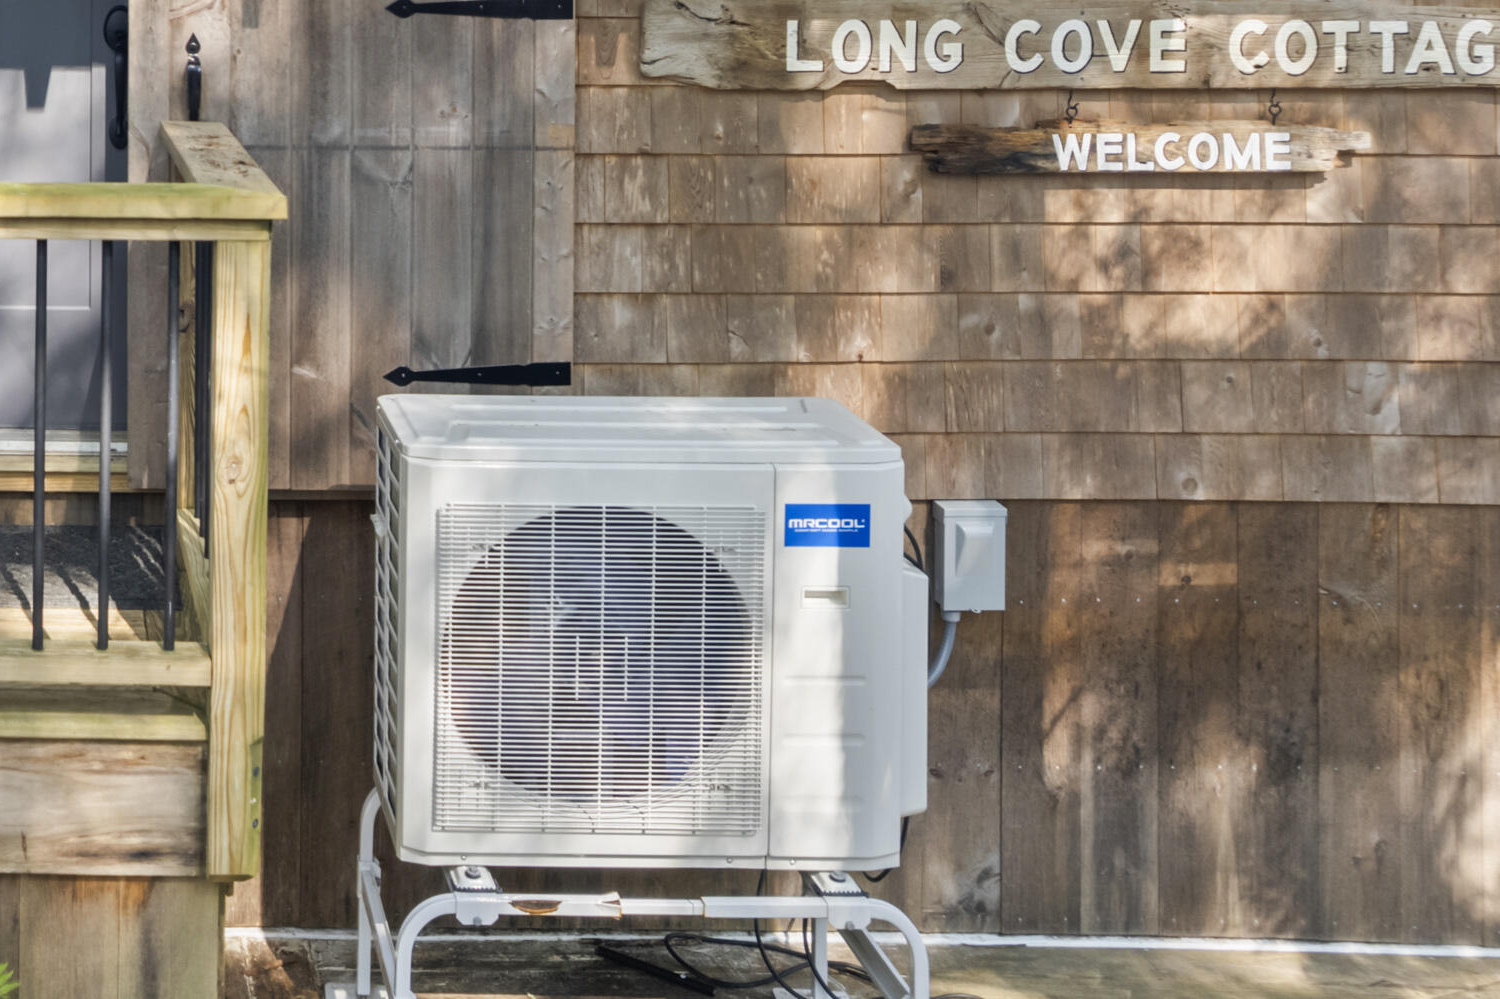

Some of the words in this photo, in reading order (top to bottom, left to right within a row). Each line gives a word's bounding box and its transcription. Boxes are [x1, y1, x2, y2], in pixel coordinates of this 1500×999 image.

[786, 19, 964, 73] LONG
[1005, 18, 1187, 73] COVE
[1052, 131, 1292, 171] WELCOME
